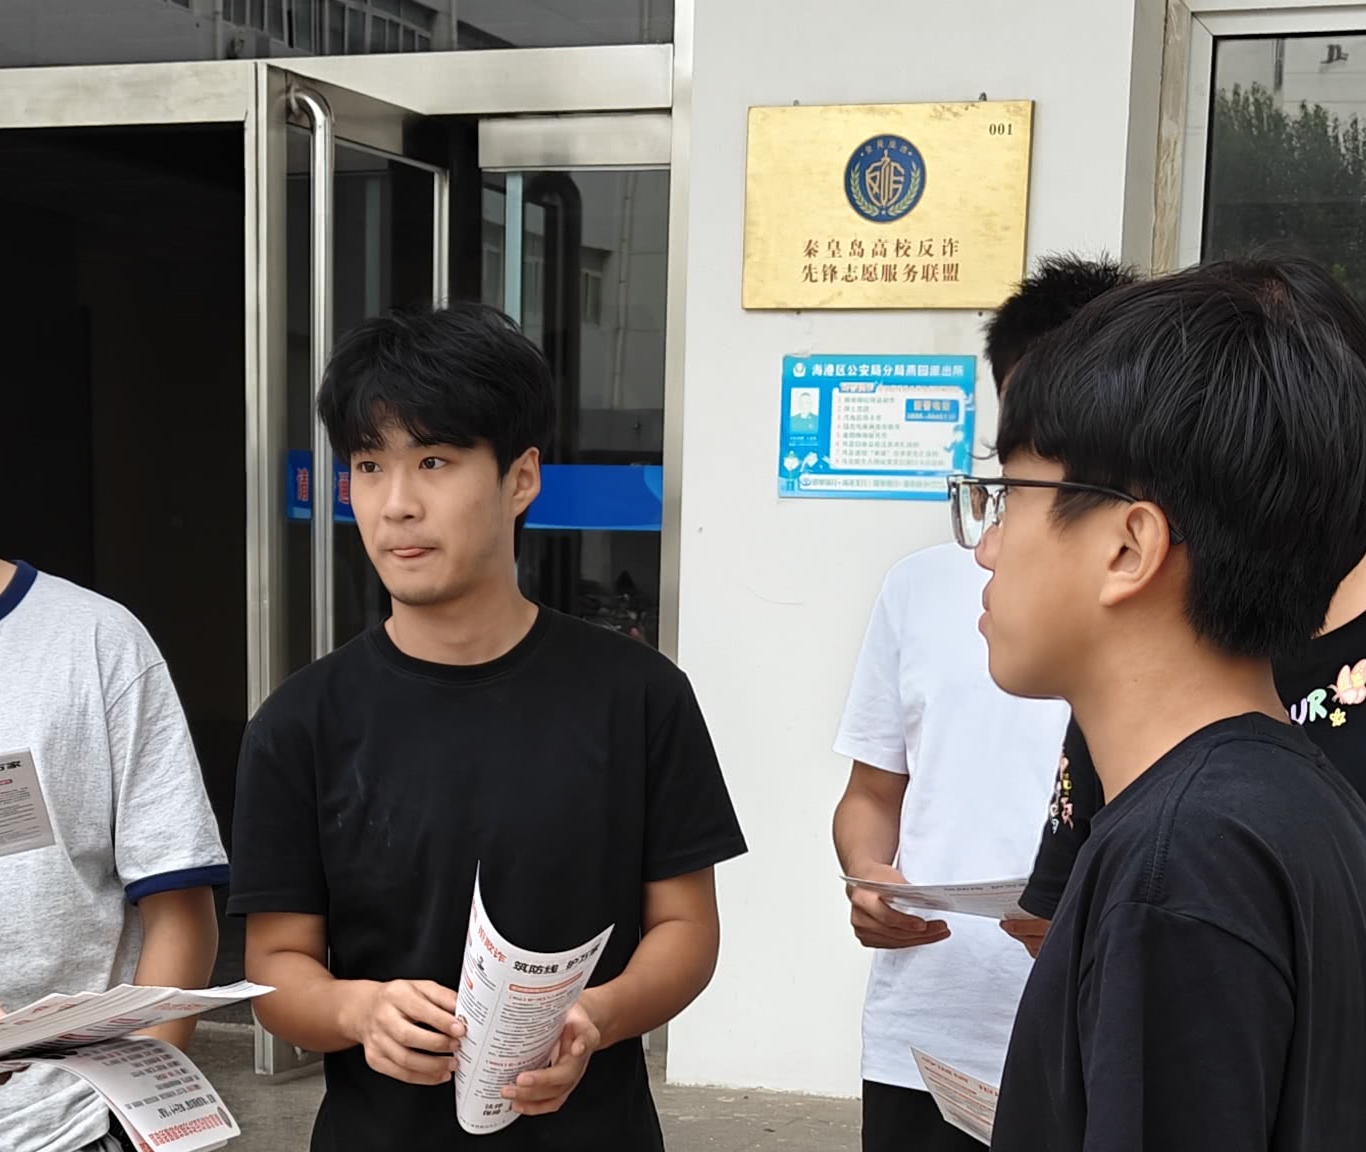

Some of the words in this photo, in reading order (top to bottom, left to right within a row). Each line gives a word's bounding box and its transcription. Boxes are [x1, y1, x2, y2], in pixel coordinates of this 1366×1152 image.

[989, 123, 1013, 136] 001
[803, 238, 960, 259] 秦皇岛高校反诈
[802, 263, 960, 284] 先锋志愿服务联盟
